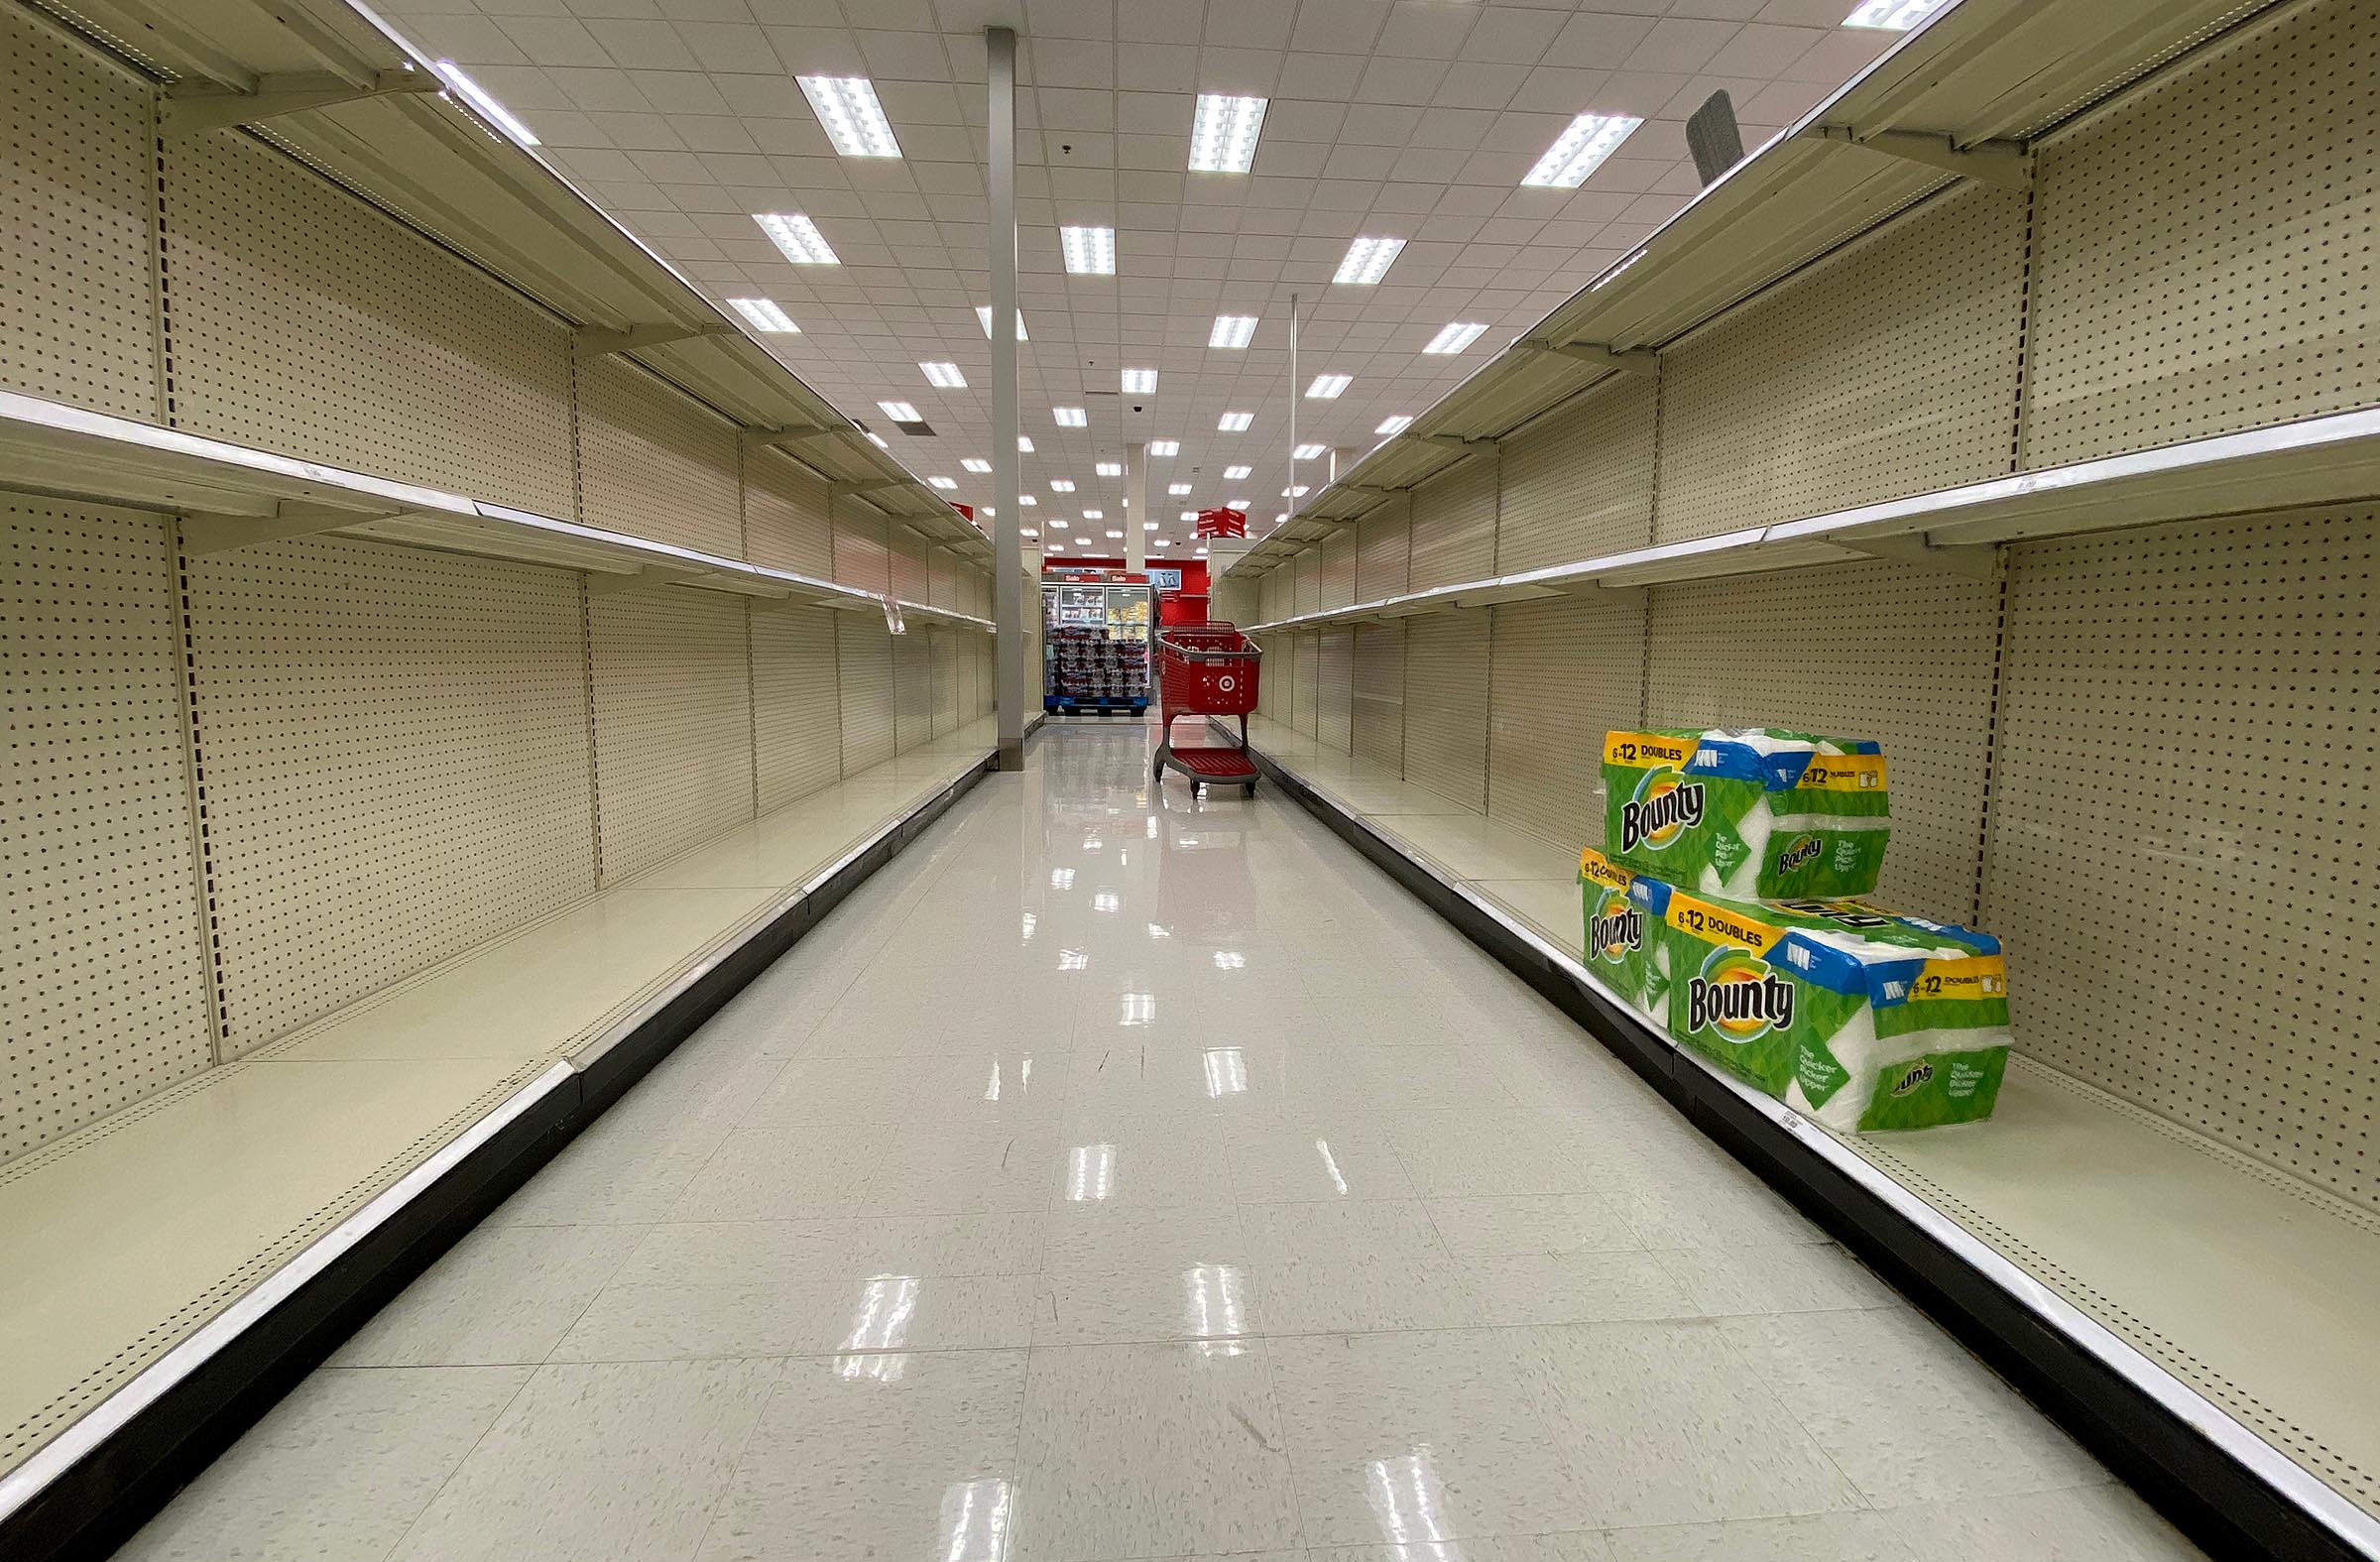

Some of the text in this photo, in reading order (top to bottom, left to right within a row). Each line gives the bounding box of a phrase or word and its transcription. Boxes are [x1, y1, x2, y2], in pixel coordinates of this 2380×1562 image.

[1640, 744, 1682, 761] DOUBLES
[1622, 781, 1704, 853] Bounty
[1590, 907, 1643, 960] Bounty
[1708, 915, 1762, 947] DOUBLES
[1689, 974, 1794, 1032] Bounty
[1799, 1054, 1838, 1074] Quicker
